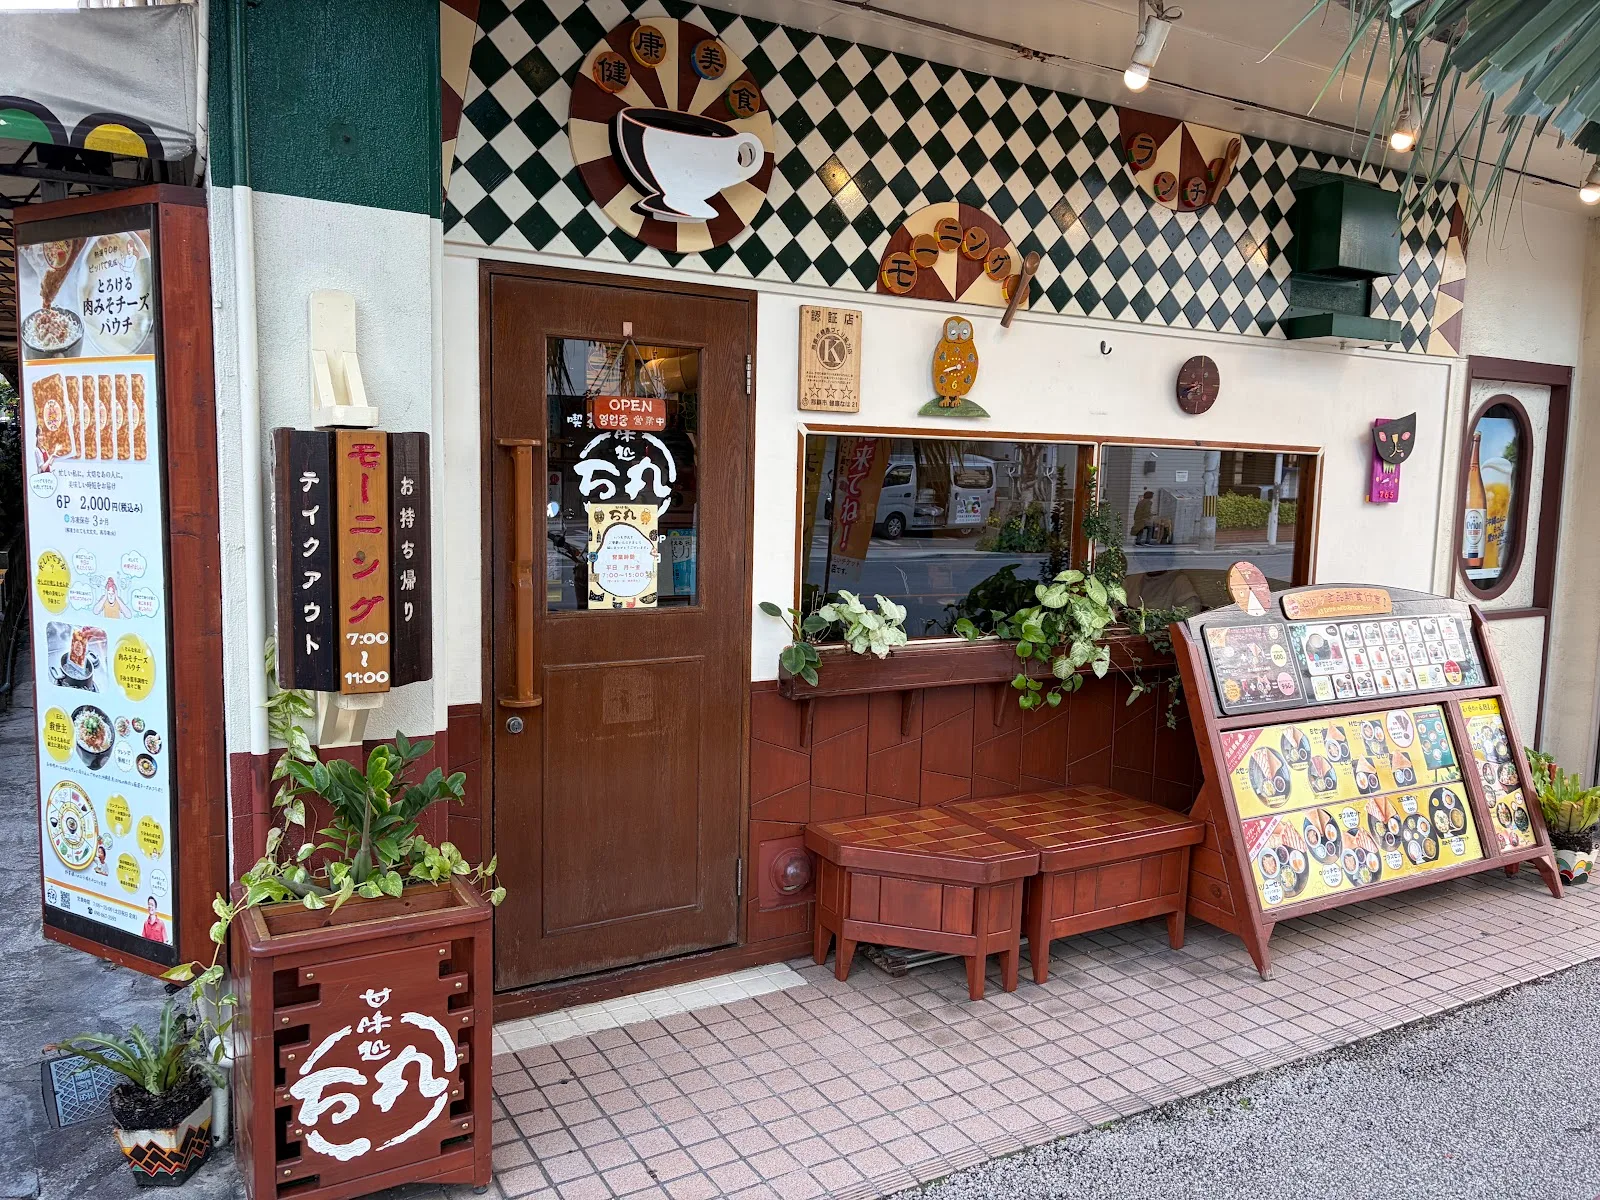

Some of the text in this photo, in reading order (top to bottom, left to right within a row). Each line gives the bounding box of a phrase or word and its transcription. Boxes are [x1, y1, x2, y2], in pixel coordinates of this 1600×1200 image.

[887, 225, 1011, 288] モーニング
[98, 277, 132, 293] とろける
[83, 292, 149, 316] 肉みそチーズ
[100, 316, 132, 335] パウチ
[811, 309, 854, 326] 認証店
[609, 399, 653, 413] OPEN
[599, 413, 665, 427] 영업중 営業中
[840, 437, 876, 549] 来てね!
[56, 494, 143, 513] 6P 2,000円(税込み)
[348, 443, 384, 624] モーニング
[400, 475, 417, 622] お持ち帰り
[299, 471, 322, 655] テイクアウト
[346, 631, 389, 646] 7:00
[344, 671, 389, 685] 11:00
